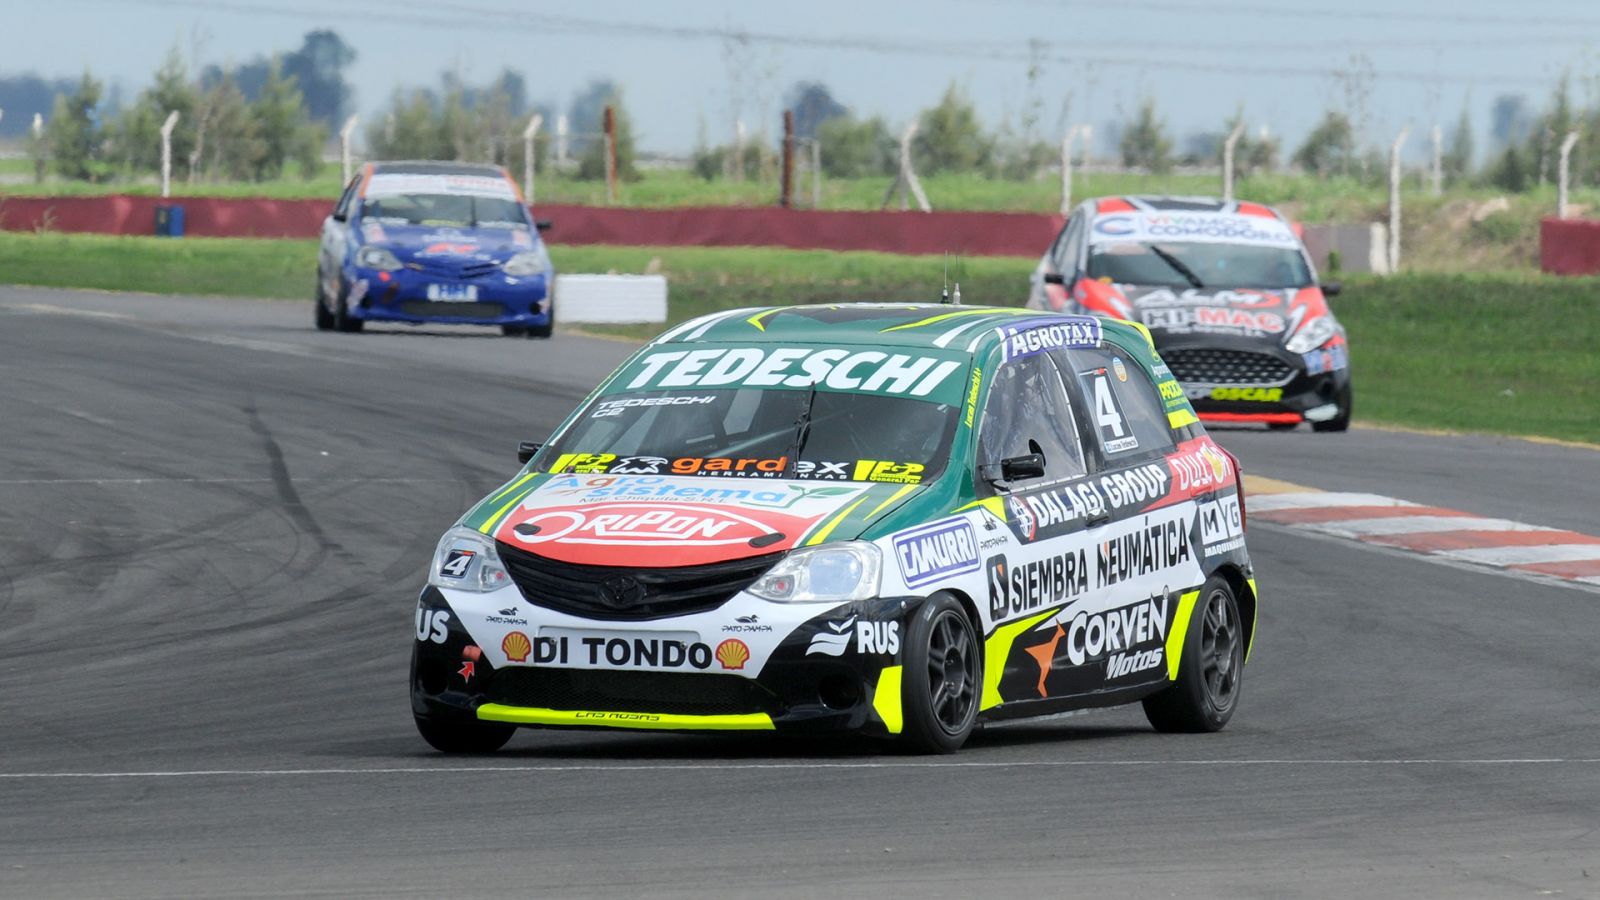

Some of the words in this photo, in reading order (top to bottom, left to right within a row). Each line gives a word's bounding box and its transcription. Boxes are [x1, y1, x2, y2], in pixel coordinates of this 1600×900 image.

[1008, 322, 1095, 357] AGROTAX
[626, 348, 961, 396] TEDESCHI
[599, 396, 717, 410] TEDESCHI
[1095, 376, 1124, 437] 4
[1211, 387, 1282, 401] OSCAR
[697, 470, 847, 480] HERRAMINTAS
[587, 483, 787, 503] sistema
[1026, 481, 1105, 528] DALAGI
[1100, 464, 1167, 509] GROUP
[1203, 501, 1240, 538] MYG
[444, 555, 469, 576] 4
[899, 525, 977, 579] CAMURRI
[1012, 548, 1088, 613] SIEMBRA
[1097, 515, 1190, 589] NEUMÁTICA
[857, 620, 899, 655] RUS
[1067, 597, 1168, 666] CORVEN
[533, 636, 568, 664] DI
[582, 637, 712, 670] TONDO
[1105, 647, 1164, 680] Motos
